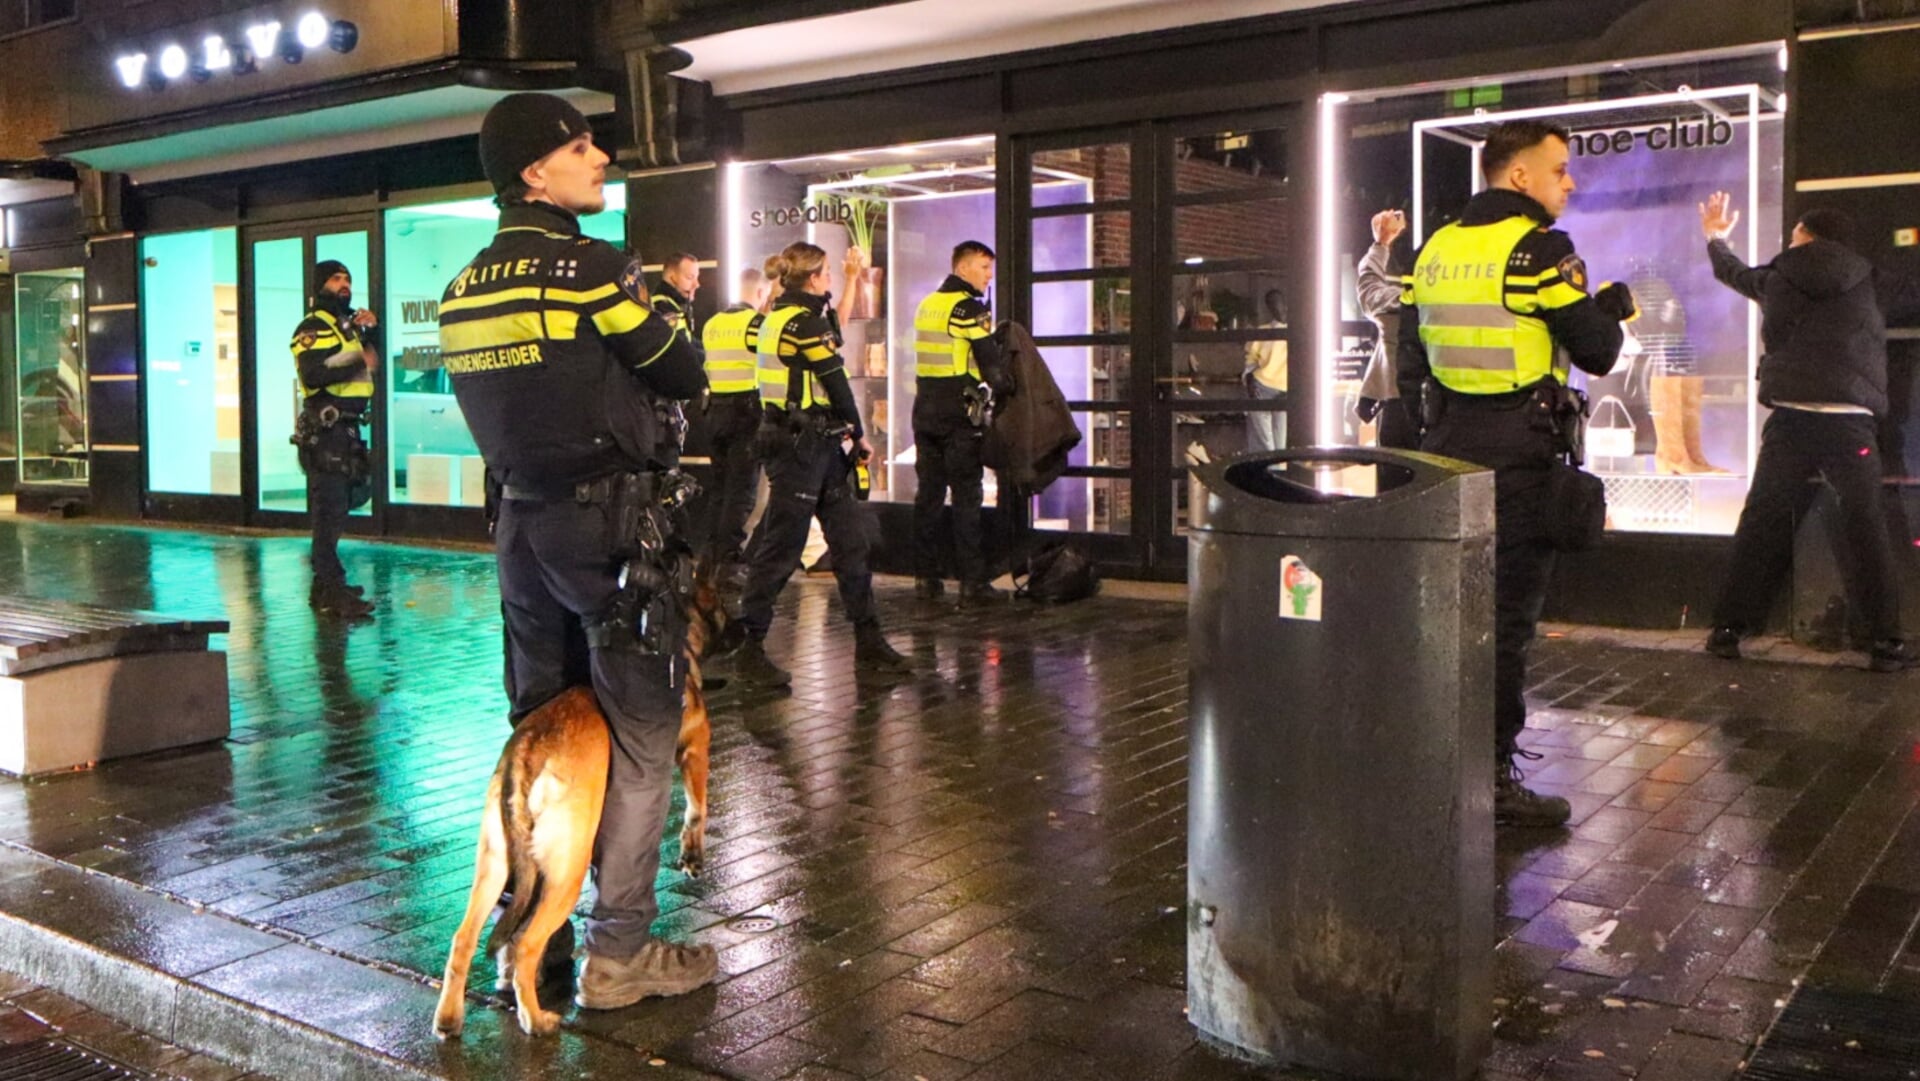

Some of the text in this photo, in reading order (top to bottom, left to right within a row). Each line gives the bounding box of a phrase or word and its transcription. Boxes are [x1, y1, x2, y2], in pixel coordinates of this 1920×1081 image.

[116, 12, 328, 87] VOLVO
[1646, 113, 1733, 150] club
[750, 198, 851, 228] shoe club
[401, 299, 439, 324] VOLVO
